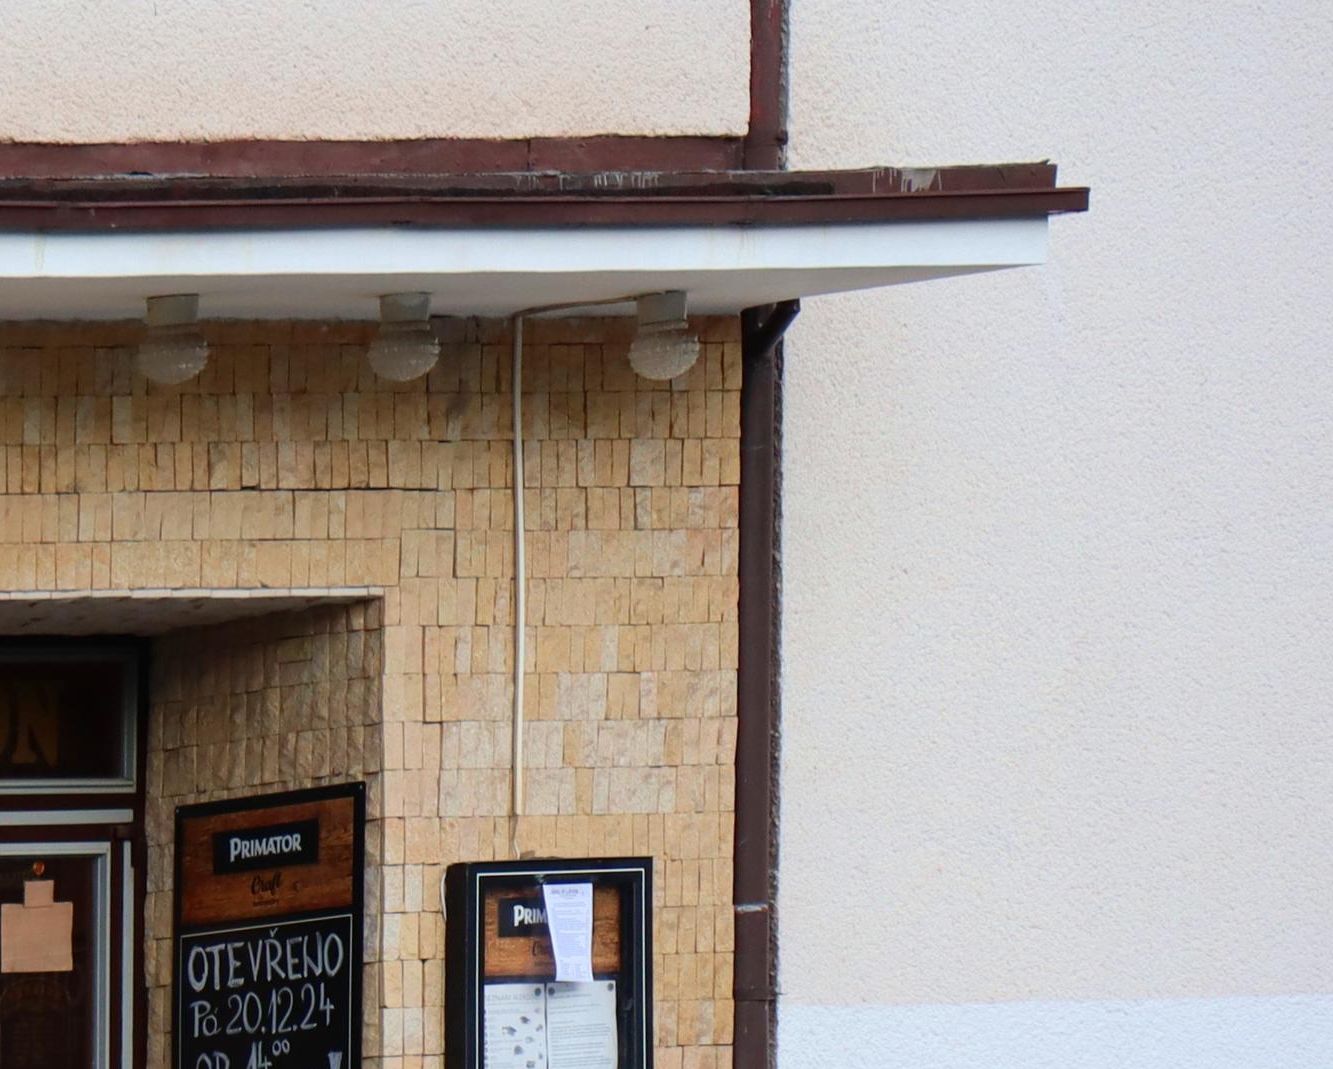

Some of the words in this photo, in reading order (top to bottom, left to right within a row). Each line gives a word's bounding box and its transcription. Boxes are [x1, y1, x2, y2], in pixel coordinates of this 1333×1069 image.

[229, 833, 302, 862] PRIMATOR
[513, 904, 548, 927] PRIM
[188, 928, 344, 992] OTEVŘENO
[190, 1001, 220, 1038] Pá
[226, 982, 335, 1034] 20.12.24
